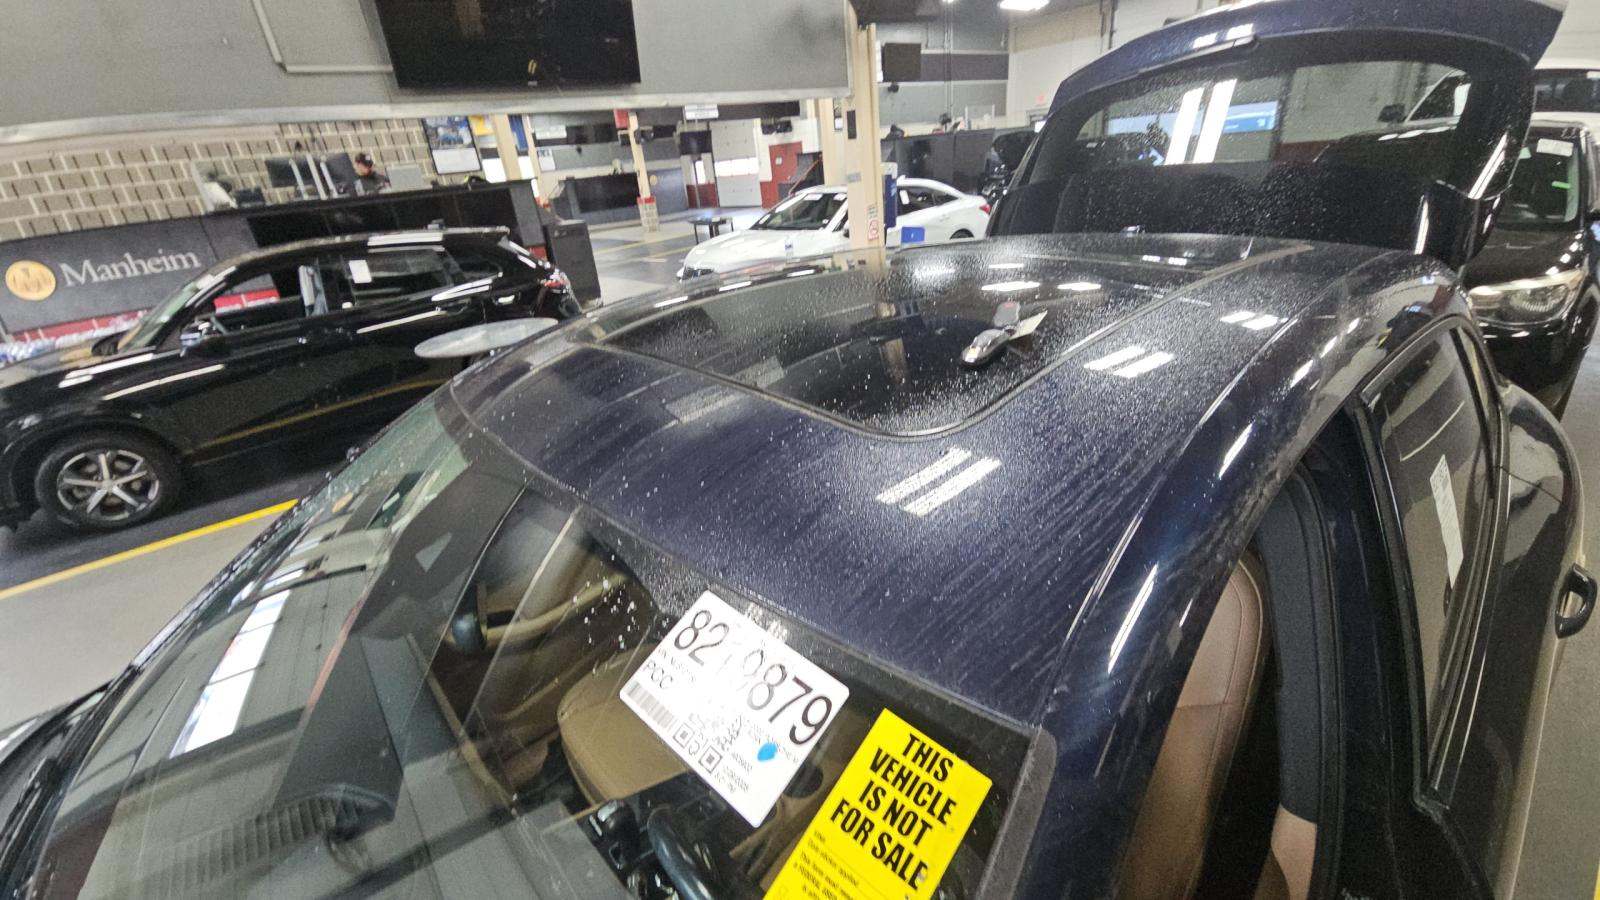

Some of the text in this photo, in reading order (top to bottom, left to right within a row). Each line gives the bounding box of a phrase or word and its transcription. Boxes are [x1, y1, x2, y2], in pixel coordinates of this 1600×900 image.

[60, 249, 201, 287] Manheim
[870, 748, 957, 825] VEHICLE
[903, 733, 953, 782] THIS
[830, 798, 875, 846] FOR
[871, 832, 928, 890] SALE
[859, 780, 933, 846] IS NOT
